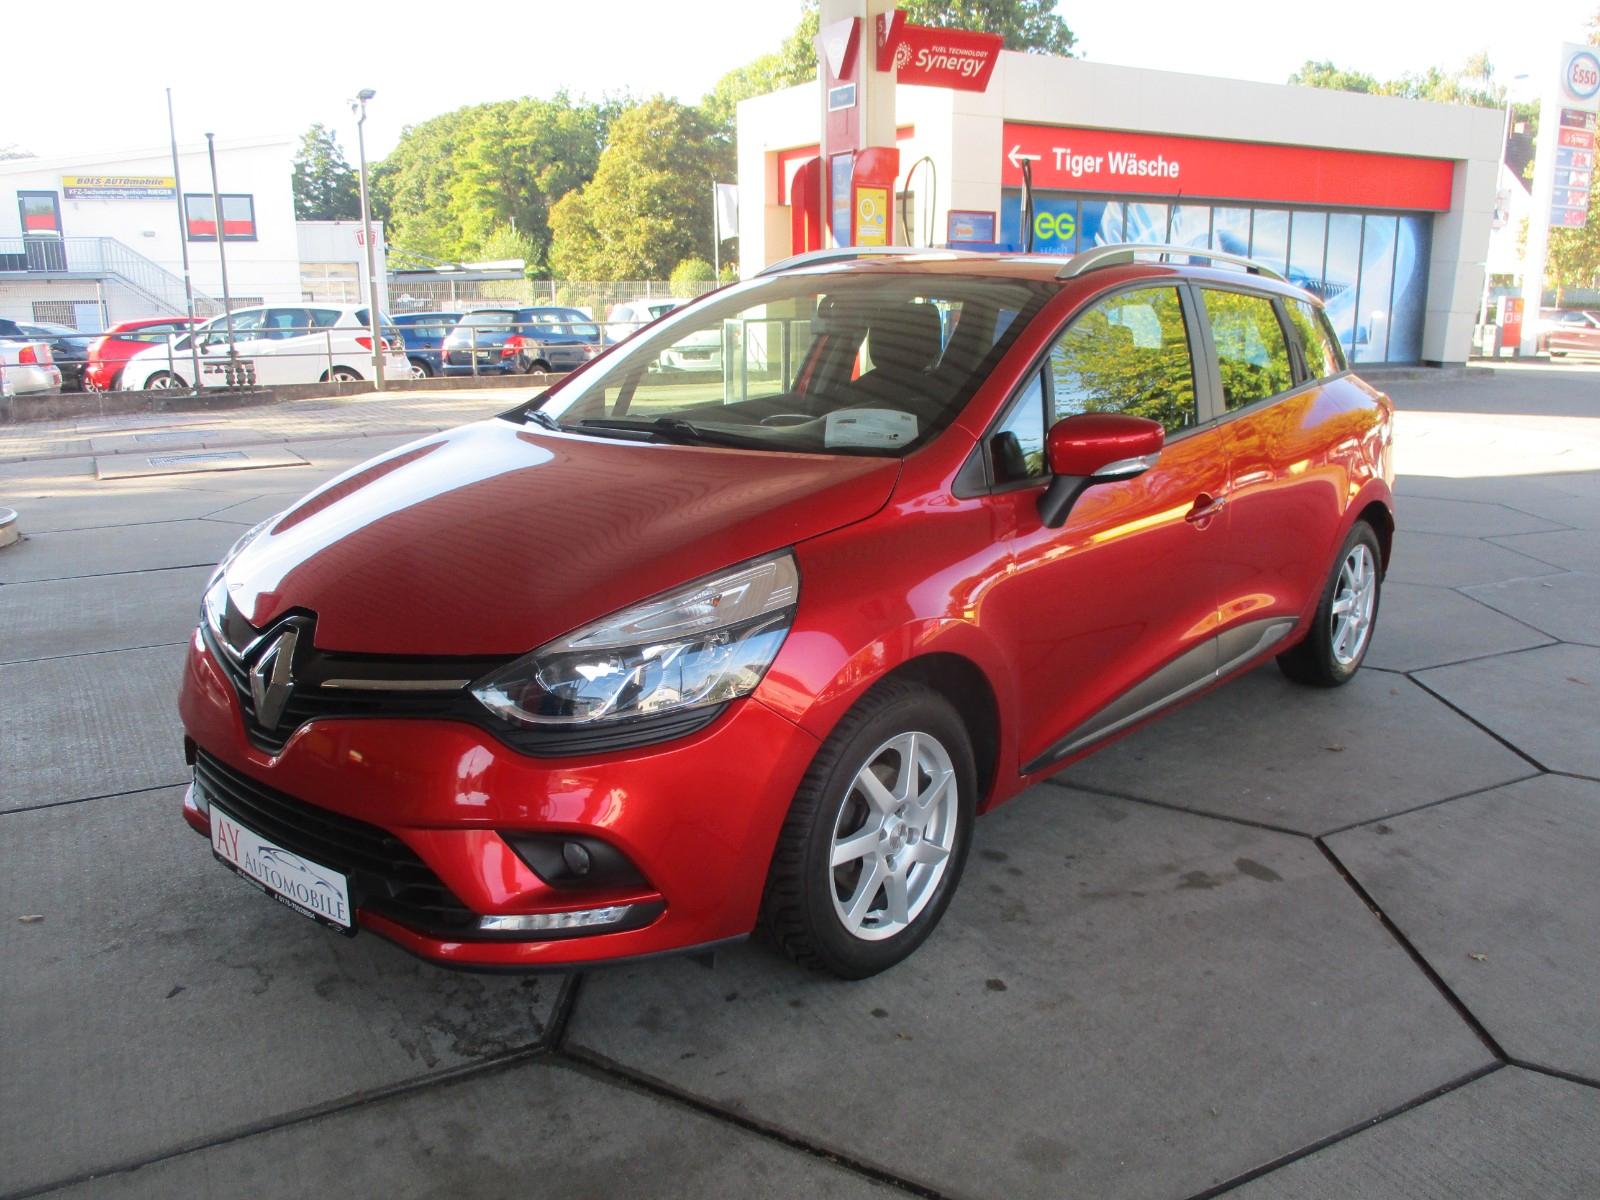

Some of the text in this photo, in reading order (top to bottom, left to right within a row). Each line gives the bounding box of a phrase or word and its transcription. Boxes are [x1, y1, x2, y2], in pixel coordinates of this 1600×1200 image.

[915, 49, 986, 77] Synergy
[931, 45, 989, 58] FUEL TECHNOLOGY
[1052, 147, 1180, 178] Tiger Wäsche
[217, 817, 240, 863] AY
[244, 851, 347, 922] AUTOMOBILE
